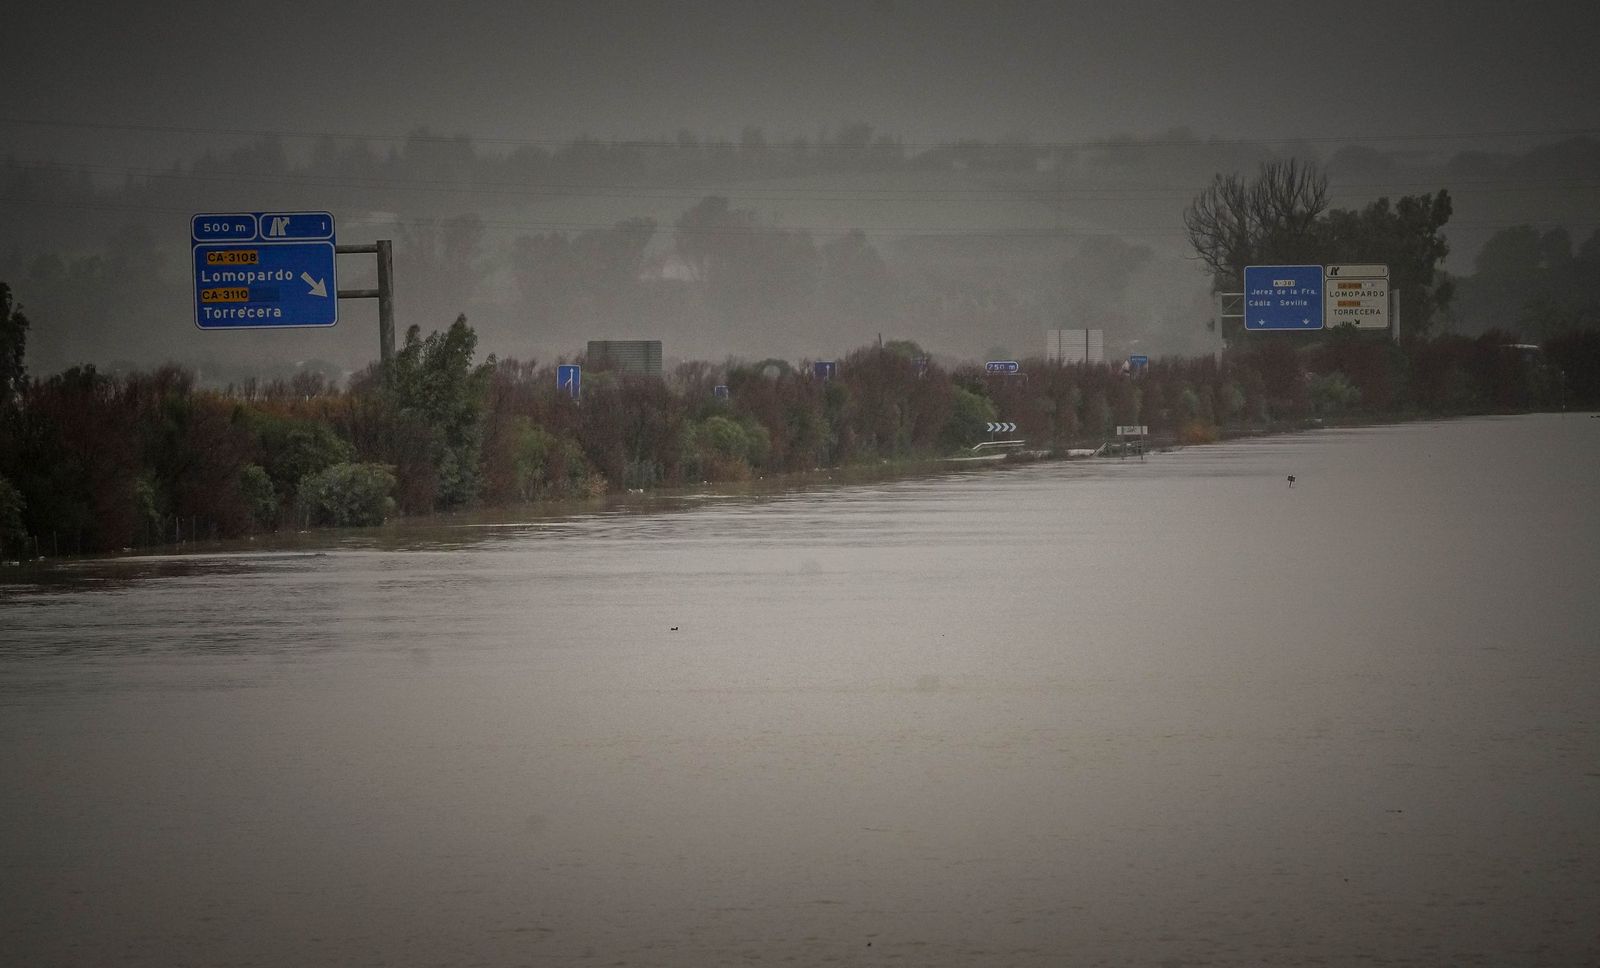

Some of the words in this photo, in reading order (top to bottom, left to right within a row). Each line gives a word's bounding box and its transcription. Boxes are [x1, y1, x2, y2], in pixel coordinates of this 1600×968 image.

[203, 223, 230, 232] 500
[235, 224, 246, 232] m
[207, 253, 257, 262] CA-3108
[202, 269, 293, 284] Lomopardo
[202, 290, 248, 299] CA-3110
[203, 306, 282, 319] Torrecera
